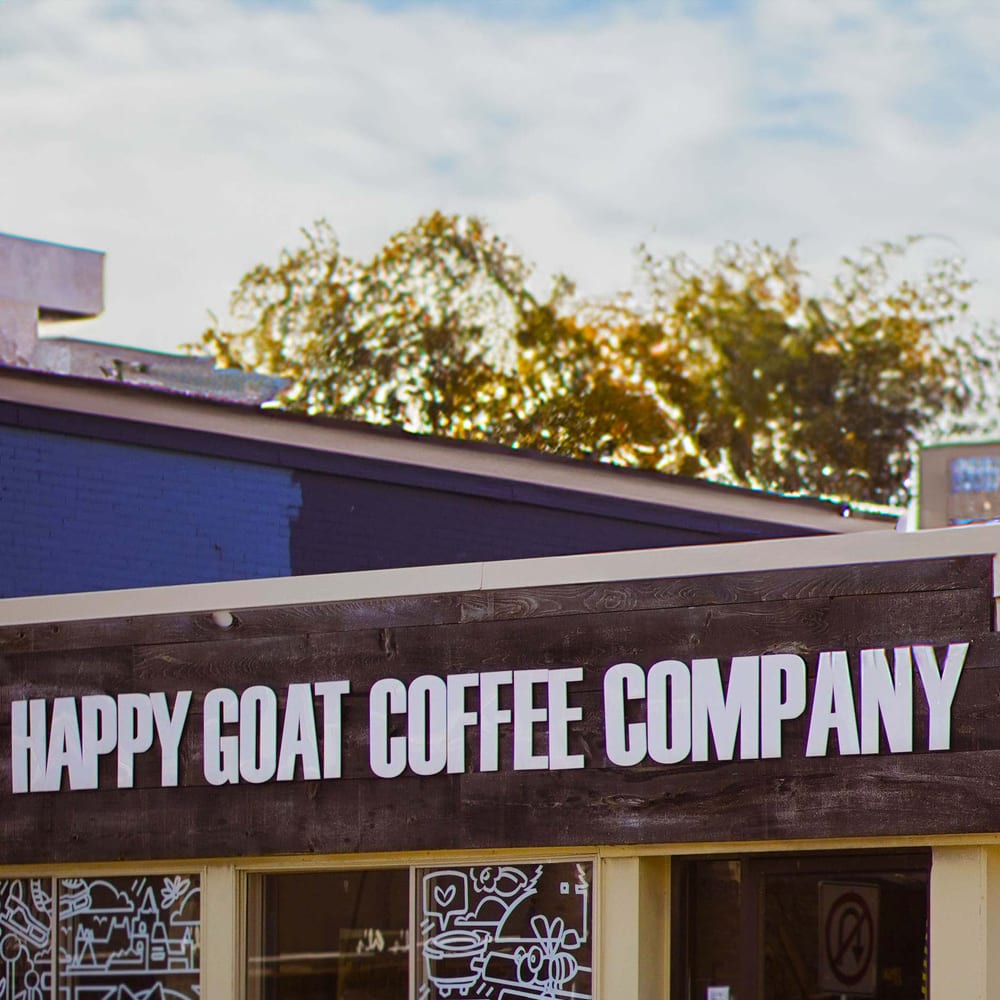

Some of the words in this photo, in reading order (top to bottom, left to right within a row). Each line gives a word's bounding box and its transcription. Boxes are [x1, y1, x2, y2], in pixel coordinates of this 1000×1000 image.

[11, 690, 193, 793] HAPPY
[203, 680, 350, 786] GOAT
[369, 667, 585, 778] COFFEE
[603, 642, 970, 767] COMPANY
